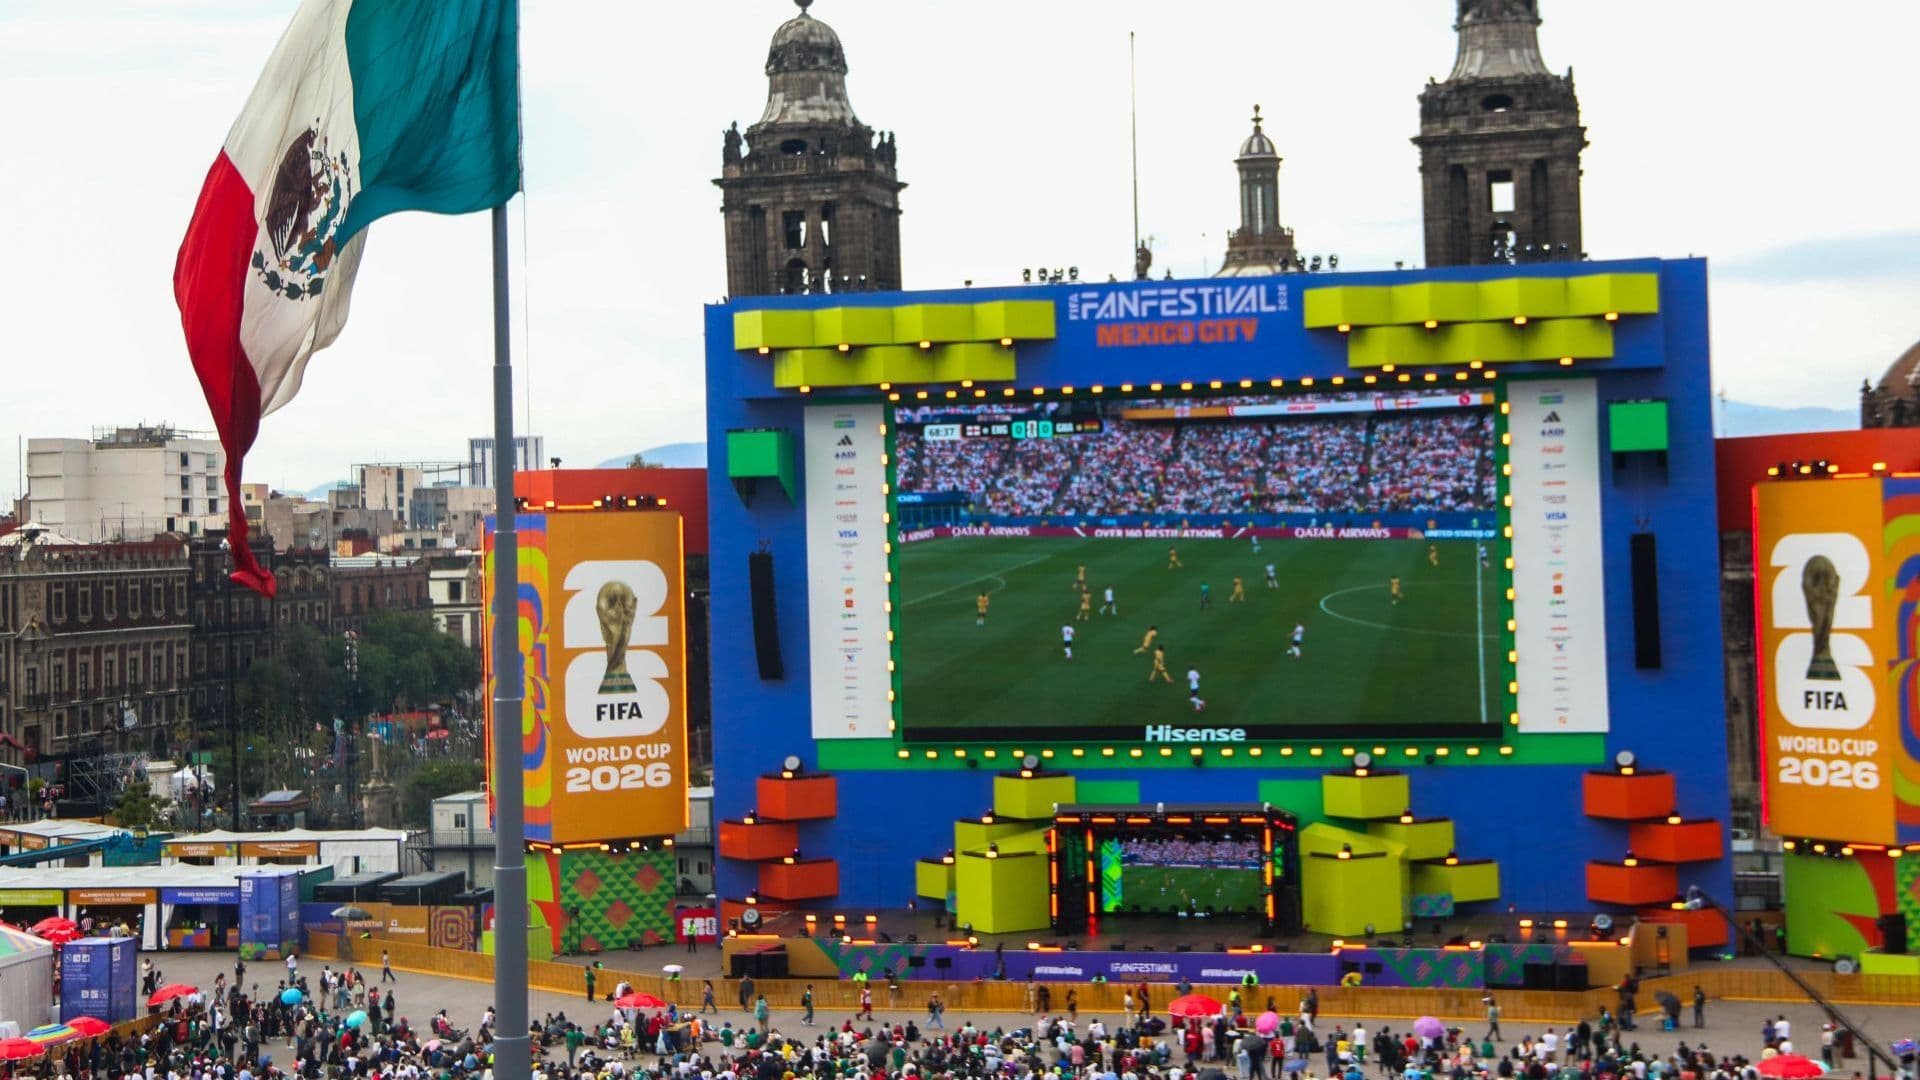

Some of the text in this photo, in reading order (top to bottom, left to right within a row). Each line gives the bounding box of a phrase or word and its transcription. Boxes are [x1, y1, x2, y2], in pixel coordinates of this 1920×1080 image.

[1097, 317, 1258, 347] MEXICO CITY
[929, 426, 955, 437] 68:37
[1546, 512, 1567, 520] VISA
[839, 530, 858, 538] VISA
[952, 527, 1030, 537] QATAR AIRWAYS
[1094, 528, 1122, 538] OVER
[1294, 528, 1390, 538] QATAR AIRWAYS
[1804, 690, 1848, 711] FIFA
[596, 702, 643, 722] FIFA
[1145, 724, 1247, 742] Hisense
[566, 743, 671, 764] WORLD CUP
[1778, 736, 1878, 757] WORLD CUP
[566, 762, 672, 793] 2026
[1778, 757, 1880, 790] 2026
